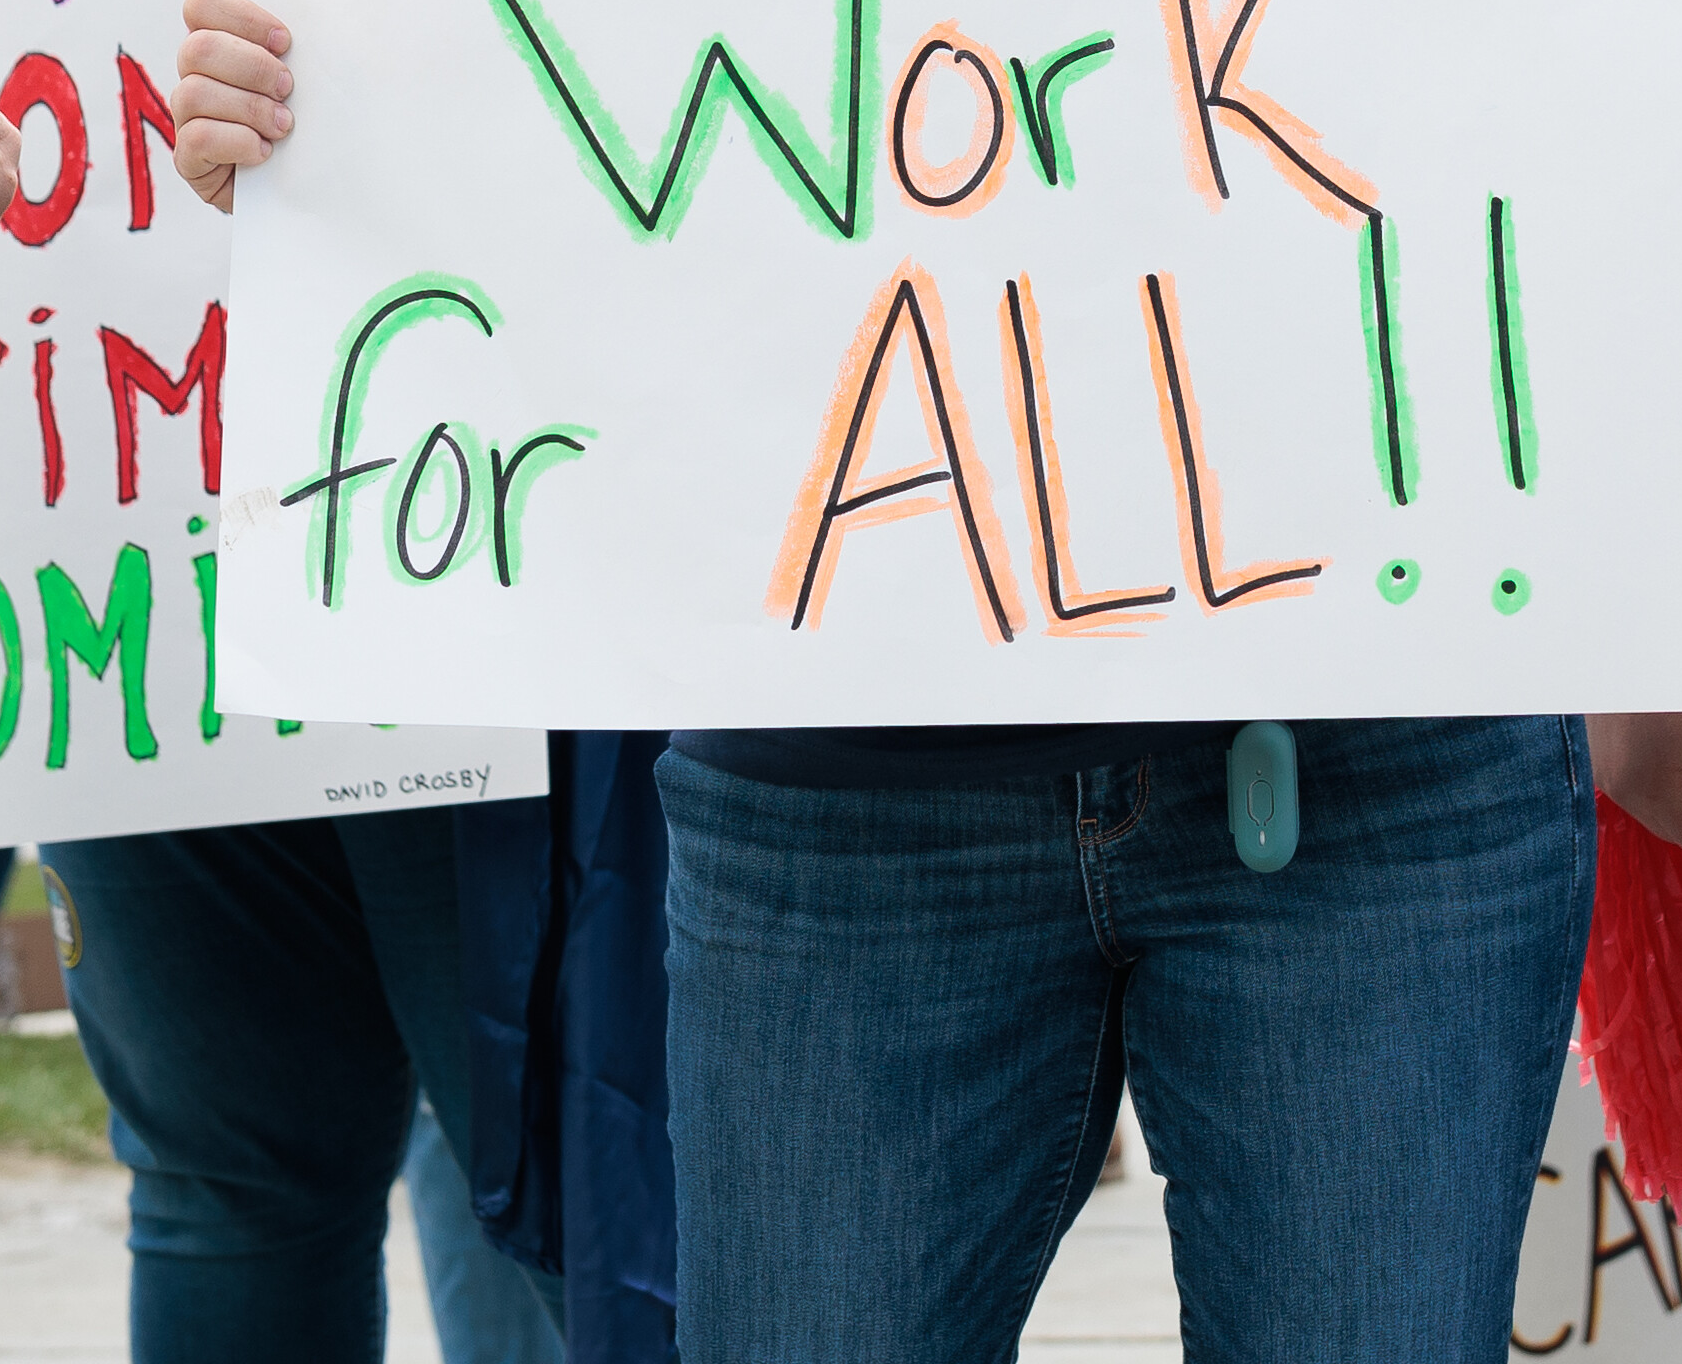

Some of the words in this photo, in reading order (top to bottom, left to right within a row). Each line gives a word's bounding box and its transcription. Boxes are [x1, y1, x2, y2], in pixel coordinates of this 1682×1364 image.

[280, 271, 599, 611] for
[323, 780, 388, 803] DAVID
[398, 763, 492, 799] CROSBY
